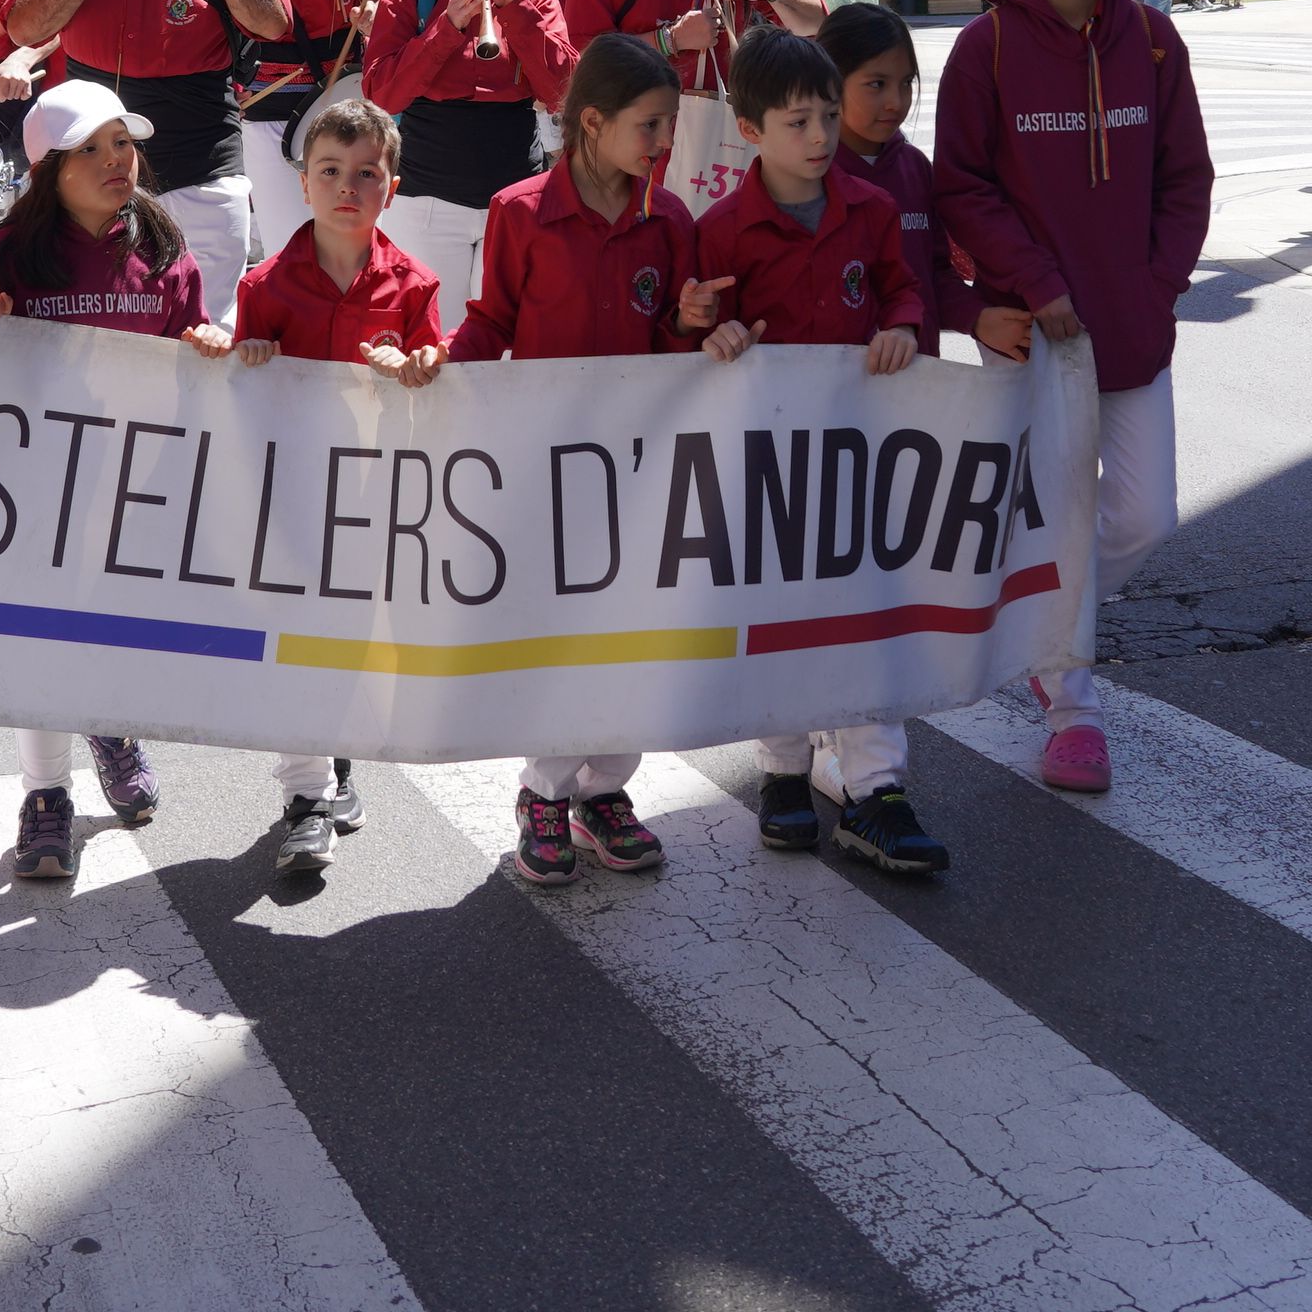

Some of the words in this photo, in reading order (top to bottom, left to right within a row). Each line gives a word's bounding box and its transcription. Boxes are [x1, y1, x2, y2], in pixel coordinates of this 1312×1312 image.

[1016, 111, 1087, 132] CASTELLERS
[26, 294, 102, 318] CASTELLERS
[105, 292, 164, 315] D'ANDORRA
[550, 424, 1045, 595] D'ANDORA
